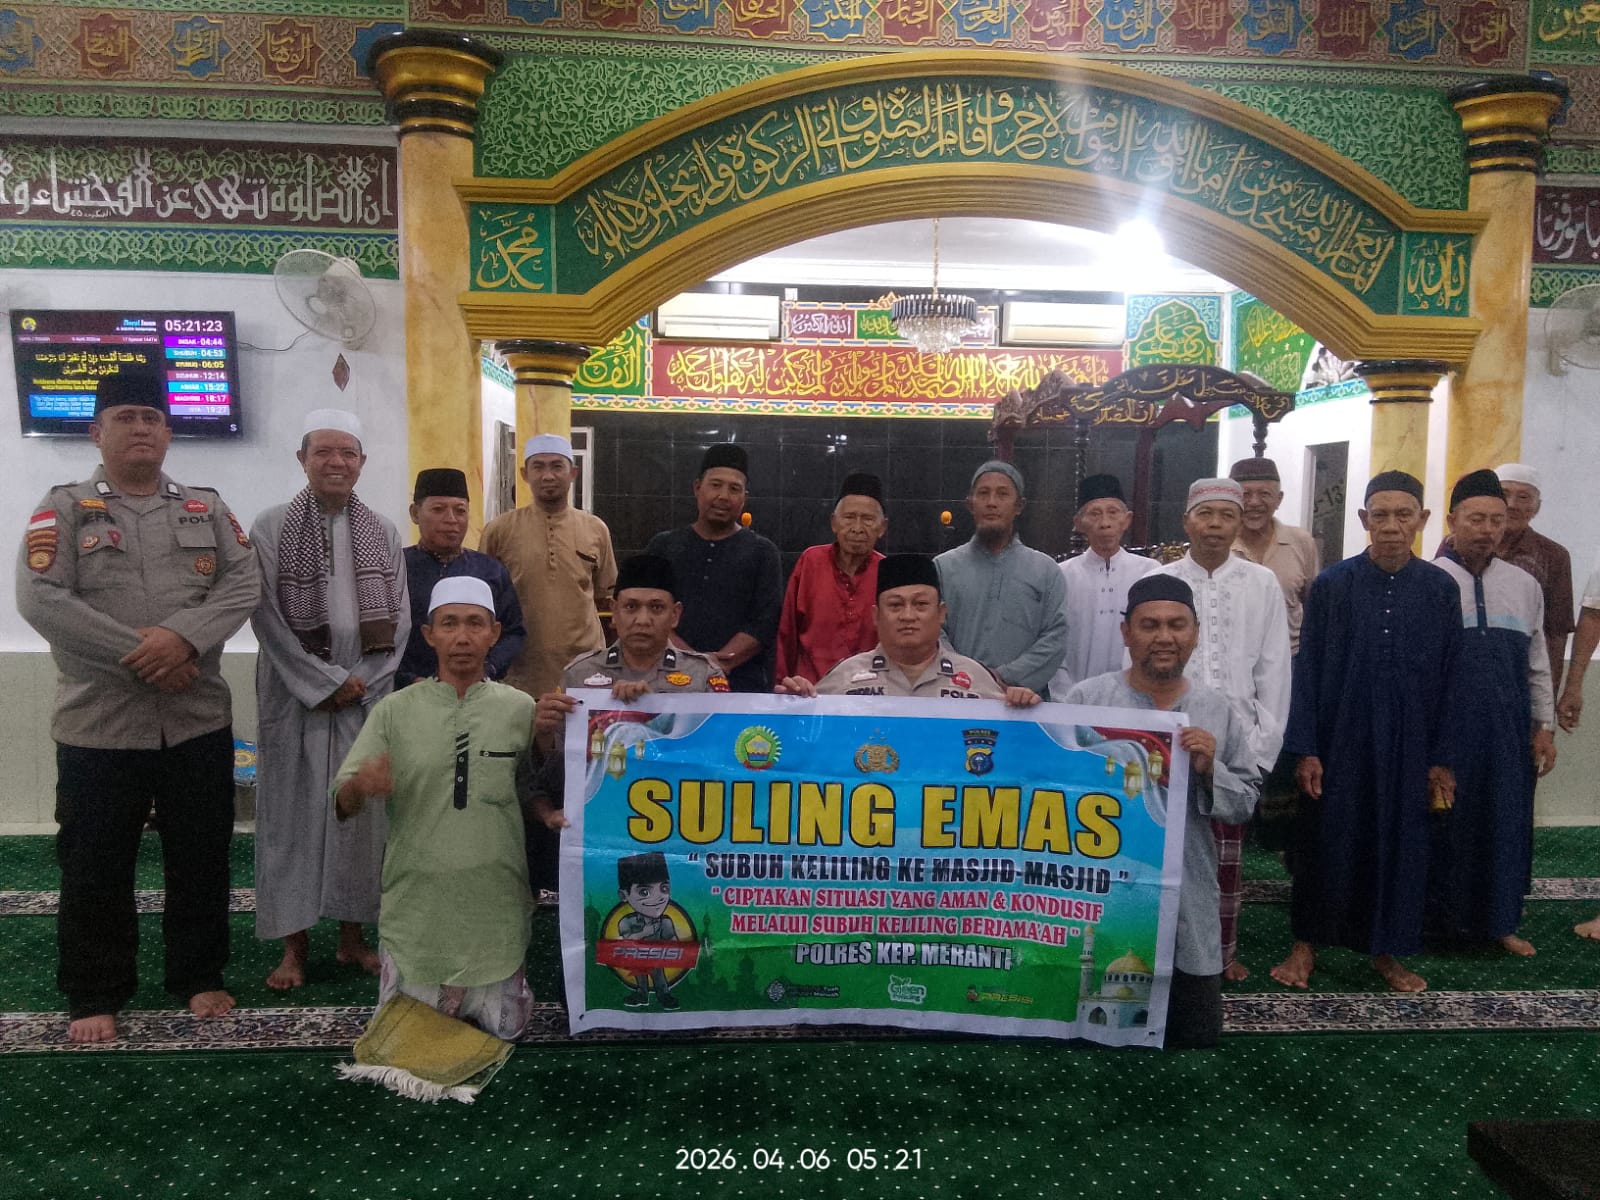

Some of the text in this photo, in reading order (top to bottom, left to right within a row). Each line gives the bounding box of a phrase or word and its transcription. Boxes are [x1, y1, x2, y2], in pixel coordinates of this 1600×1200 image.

[164, 319, 224, 332] 05:21:23
[200, 337, 223, 346] 04:44
[201, 360, 225, 369] 06:05
[202, 372, 225, 380] 12:14
[626, 778, 1122, 859] SULING EMAS
[791, 854, 890, 881] KELILING
[897, 857, 925, 882] KE
[815, 888, 887, 907] SITUASI
[890, 890, 935, 909] YANG
[940, 891, 989, 909] AMAN
[992, 892, 1005, 910] &
[1009, 893, 1103, 922] KONDUSIF
[731, 914, 808, 933] MELALUI
[811, 915, 873, 934] SUBUH
[876, 916, 957, 935] KELILING
[612, 946, 685, 960] PRESISI
[795, 941, 1012, 970] POLRES KEP. MERANTI
